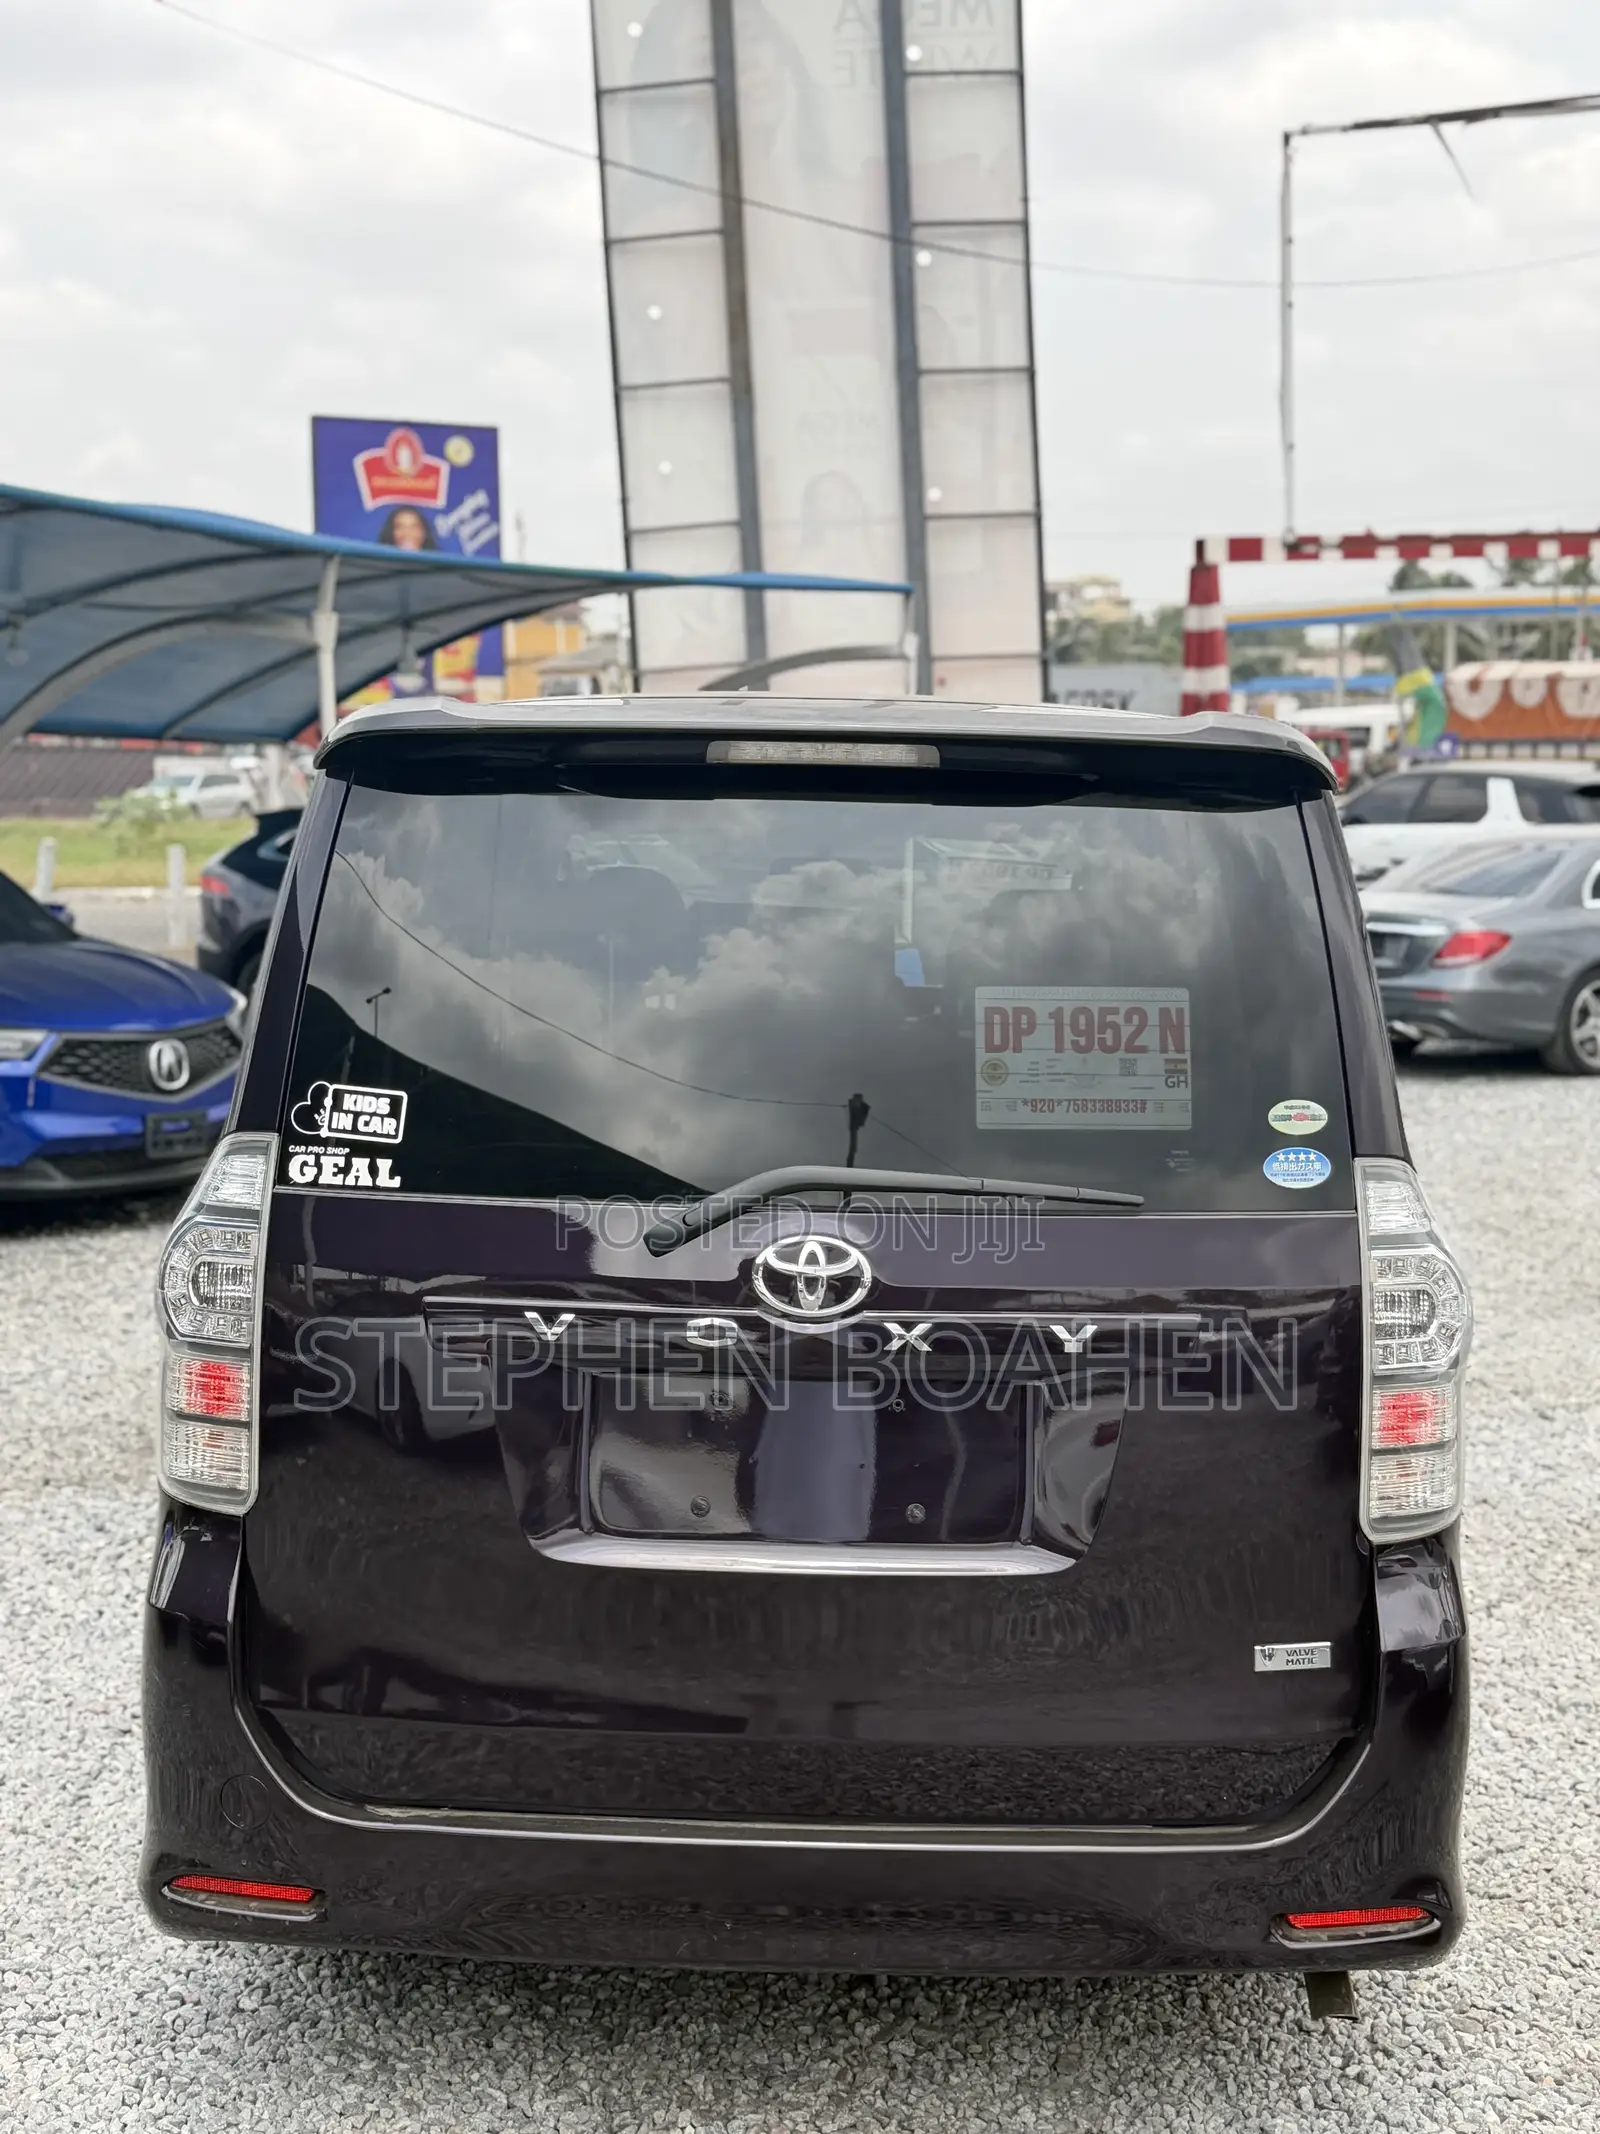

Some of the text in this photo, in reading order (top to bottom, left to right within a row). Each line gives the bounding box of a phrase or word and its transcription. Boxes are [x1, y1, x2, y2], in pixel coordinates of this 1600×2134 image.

[984, 1006, 1186, 1054] DP 1952 N
[1165, 1075, 1188, 1088] GH
[342, 1093, 391, 1115] KIDS
[331, 1112, 397, 1135] IN CAR
[288, 1145, 350, 1155] CAR PRO SHOP
[288, 1154, 401, 1188] GEAL
[1286, 1648, 1317, 1657] VALVE
[1286, 1657, 1317, 1666] MATIC
